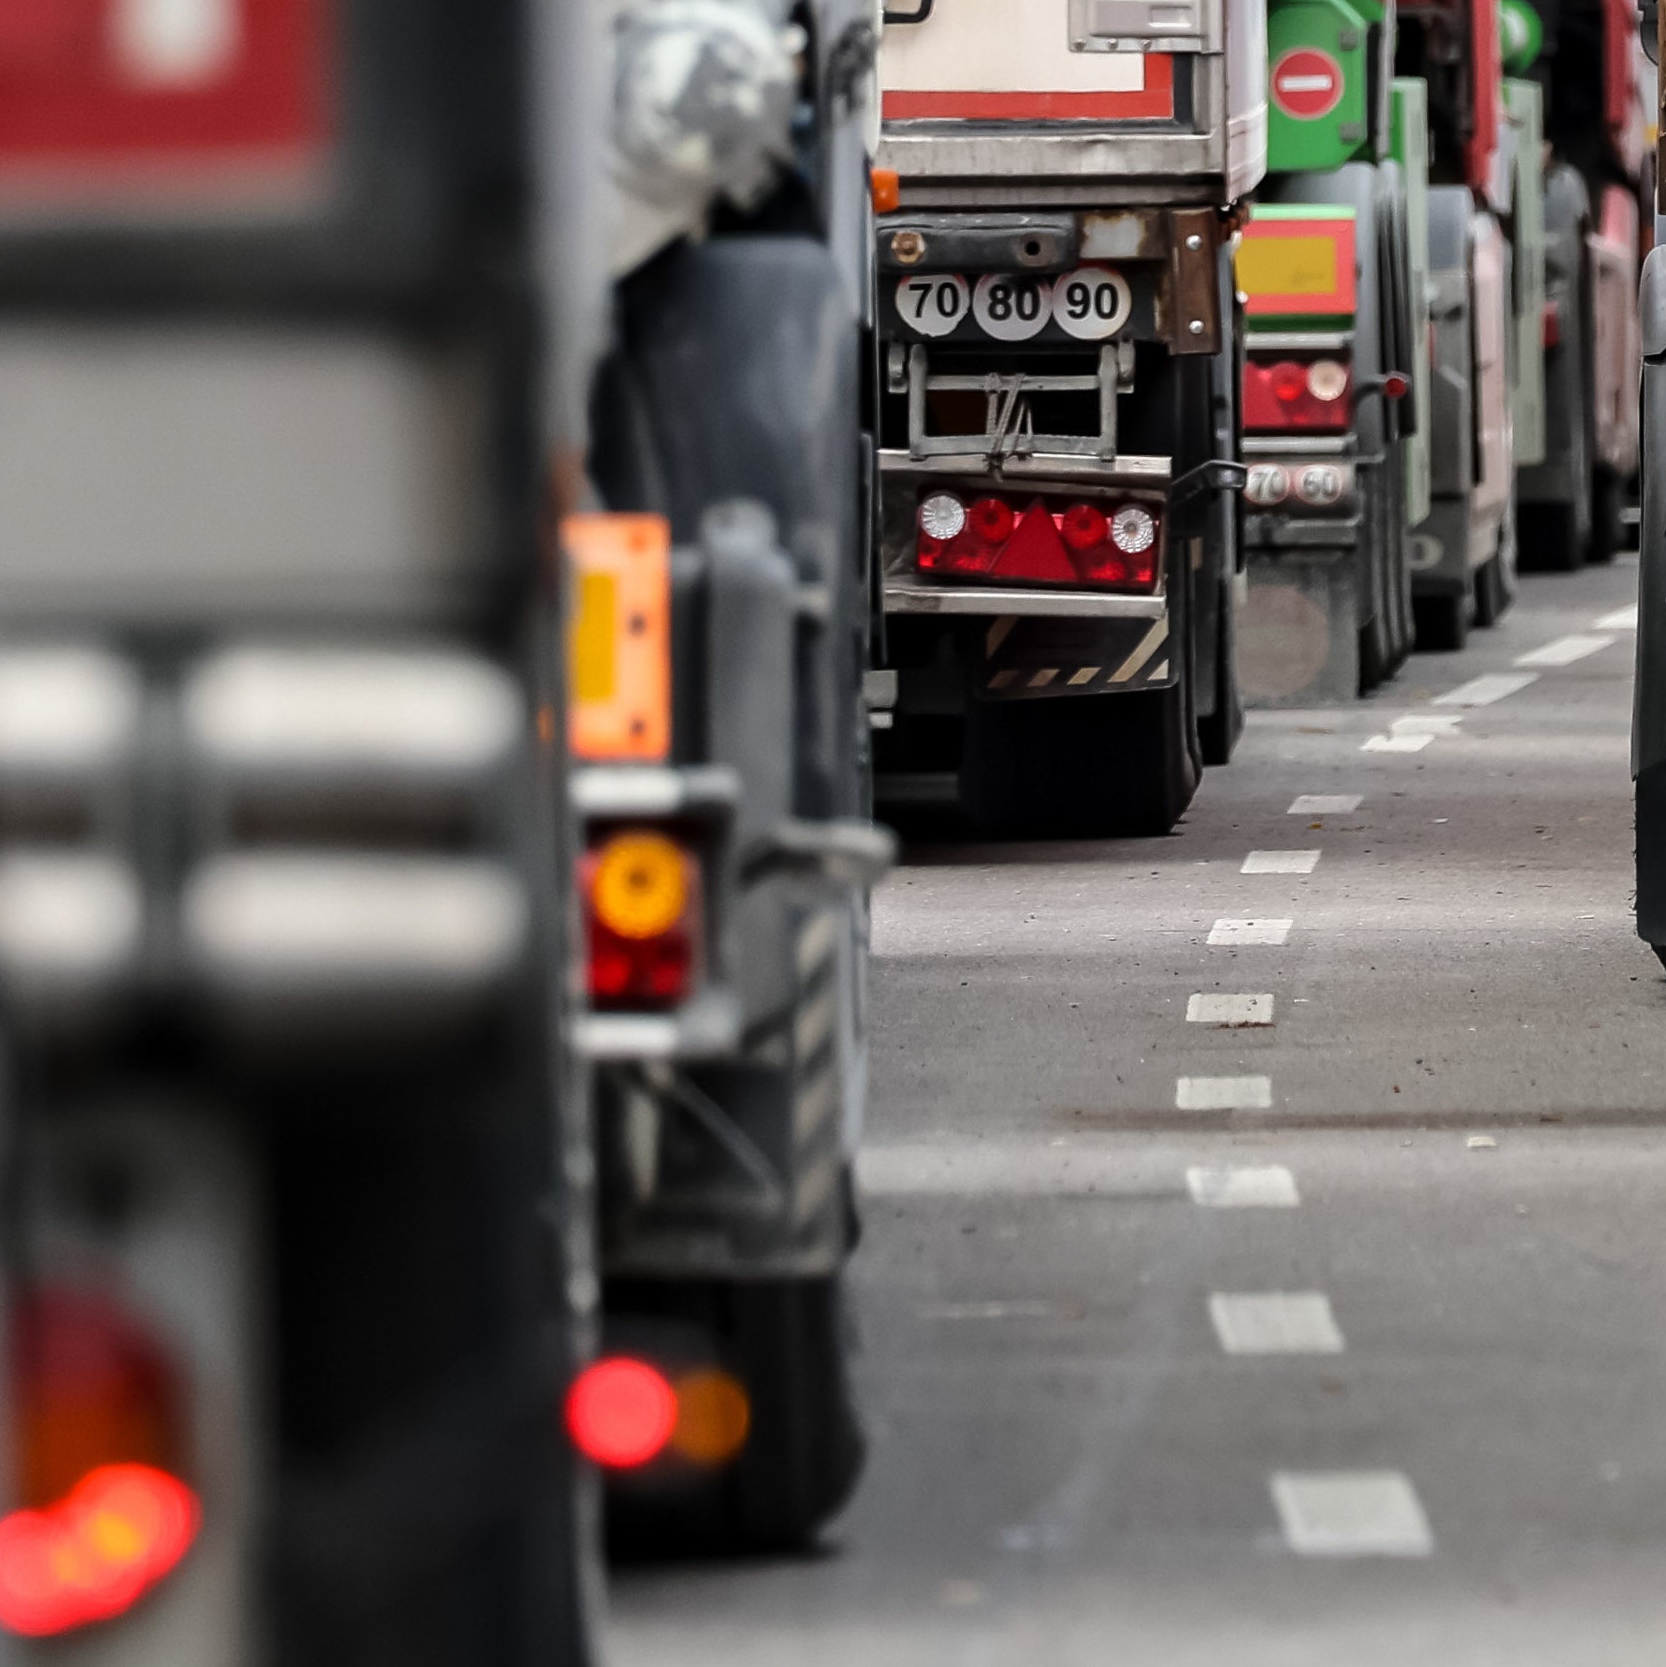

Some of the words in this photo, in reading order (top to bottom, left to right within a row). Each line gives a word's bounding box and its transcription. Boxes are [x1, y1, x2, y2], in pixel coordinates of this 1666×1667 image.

[908, 282, 959, 318] 70
[988, 284, 1041, 321] 80
[1066, 282, 1119, 320] 90
